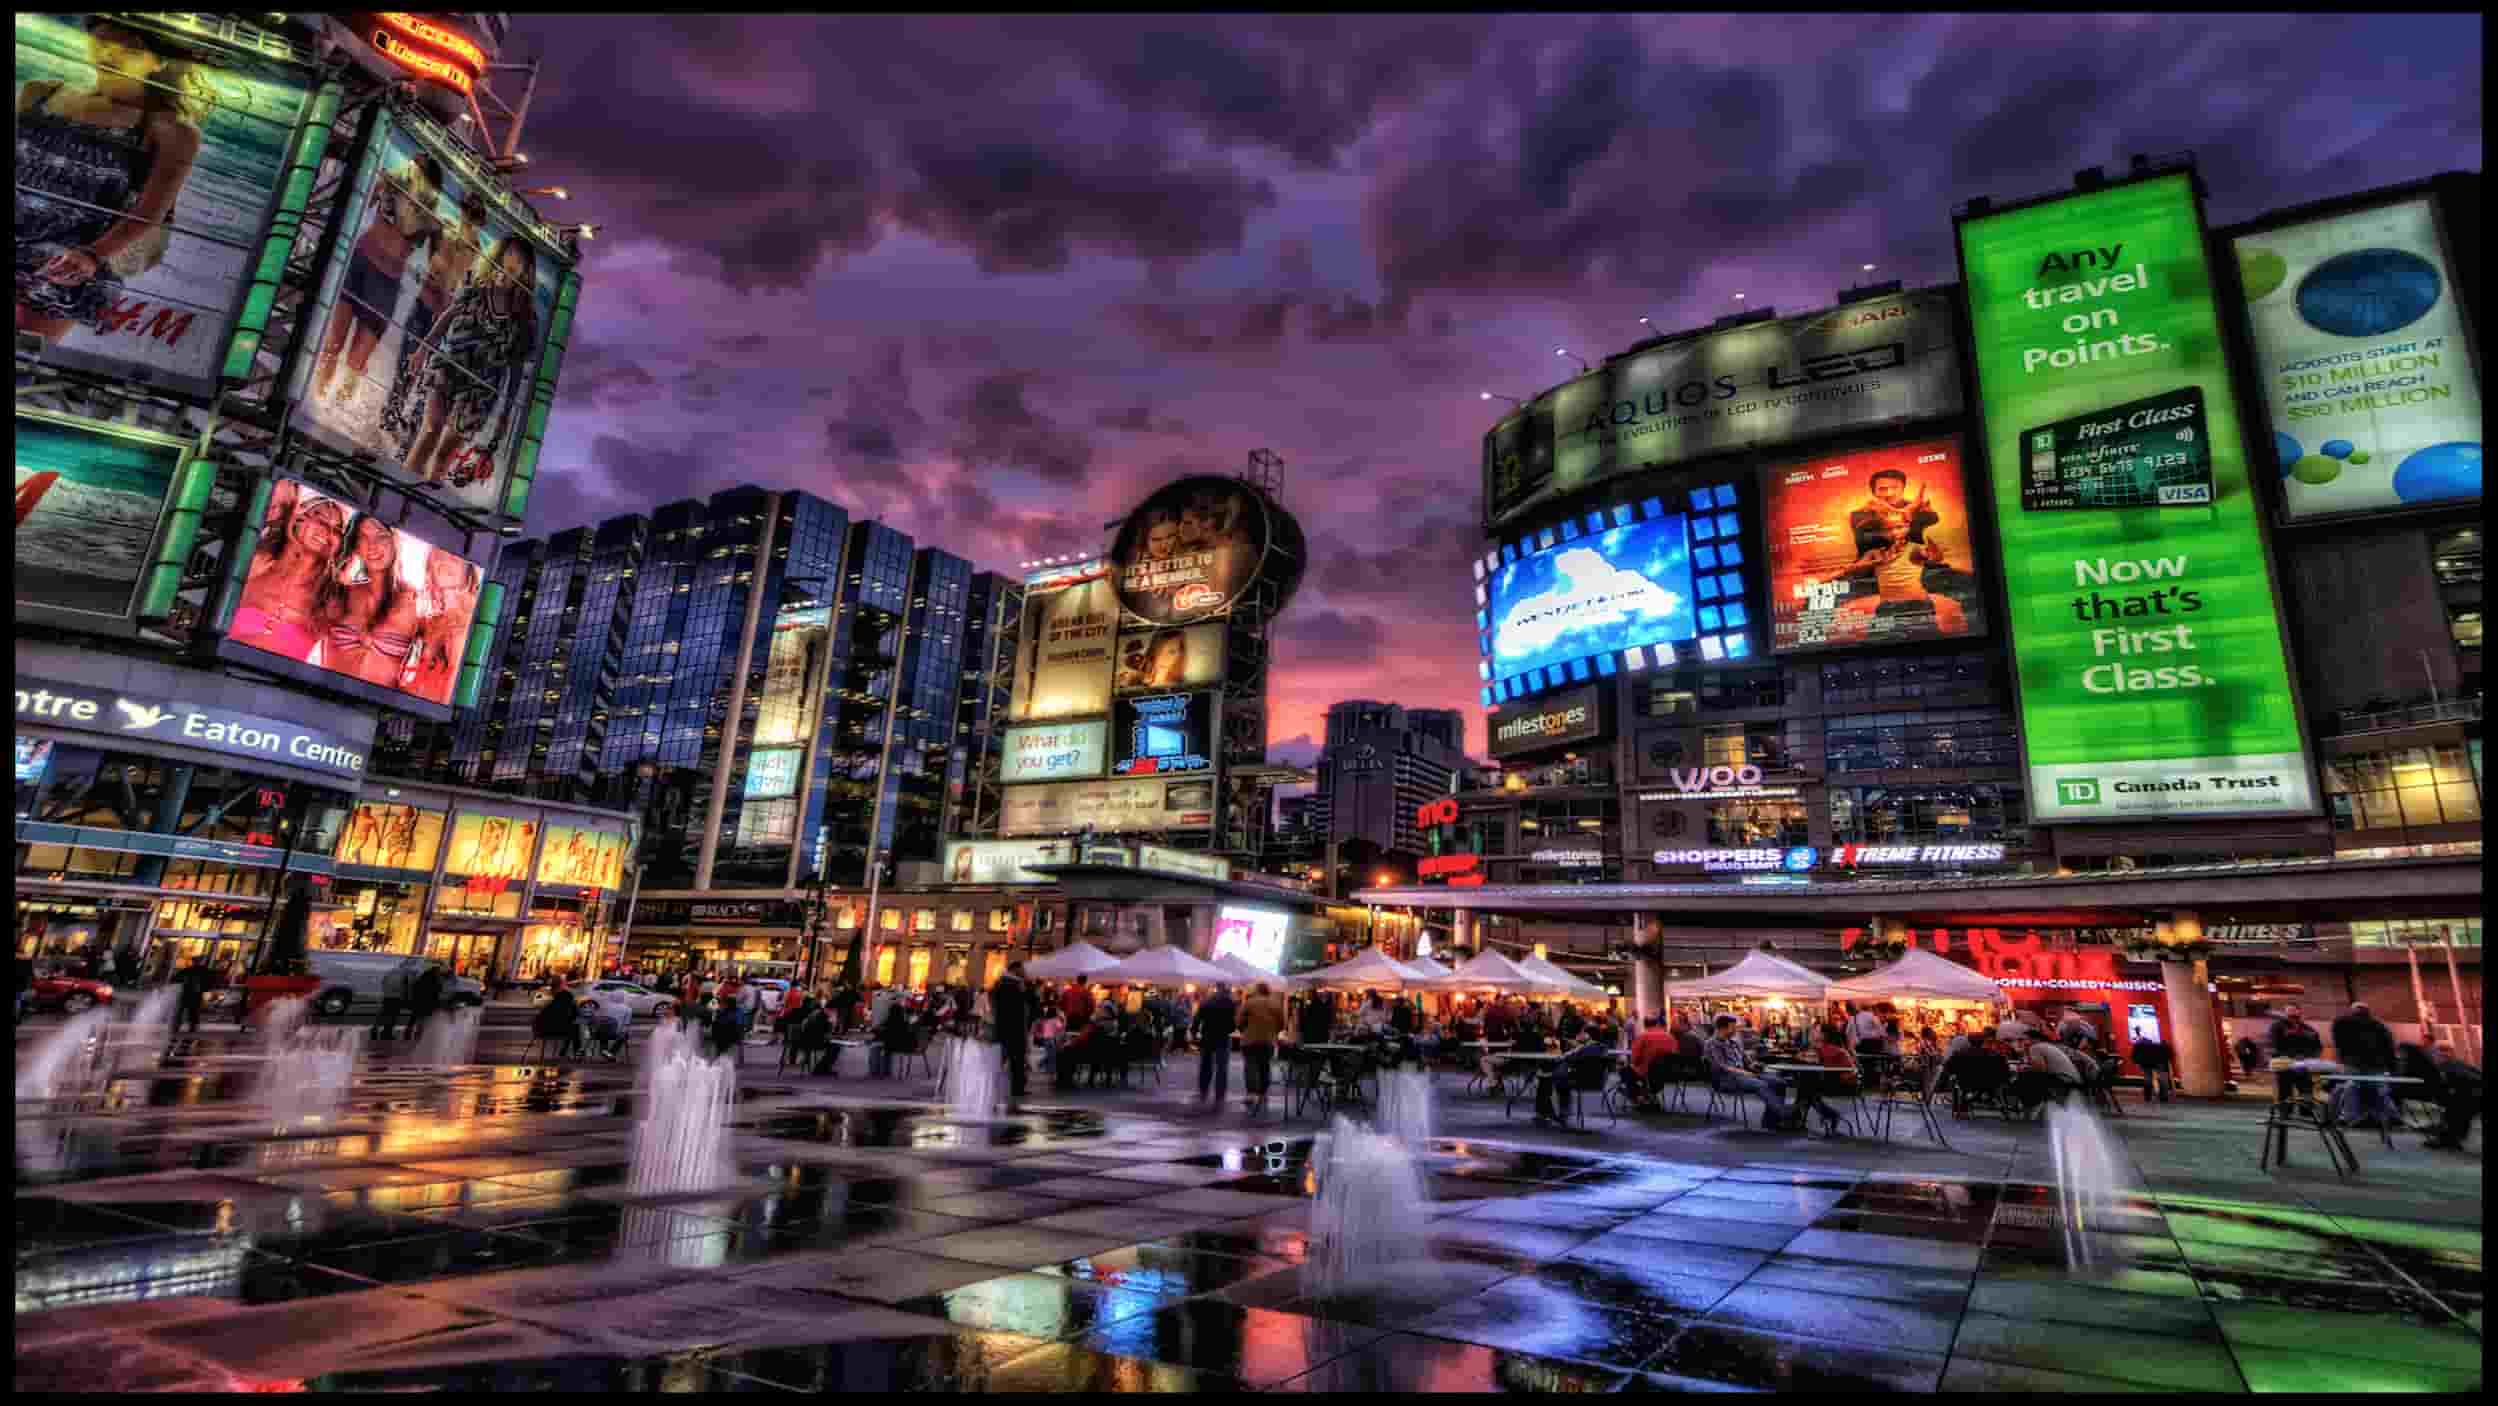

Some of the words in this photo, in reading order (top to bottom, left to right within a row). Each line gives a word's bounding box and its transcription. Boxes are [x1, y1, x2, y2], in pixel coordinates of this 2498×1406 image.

[2040, 241, 2124, 277] Any
[2023, 263, 2148, 309] travel
[2063, 307, 2119, 333] on
[2367, 342, 2417, 360] START
[2328, 353, 2441, 384] MILLION
[2364, 374, 2425, 393] REACH
[1585, 373, 1738, 433] AQUOS
[1767, 343, 1906, 390] LED
[2341, 384, 2451, 414] MILLION
[2078, 417, 2124, 440] First
[2128, 402, 2198, 429] Class
[2164, 486, 2208, 500] VISA
[2074, 555, 2188, 587] Now
[2072, 585, 2204, 622] that's
[2092, 623, 2197, 657] First
[2082, 662, 2217, 693] Class.
[1498, 705, 1586, 741] milestones
[183, 713, 281, 753] Eaton
[289, 734, 364, 772] Centre
[2063, 783, 2097, 801] TD
[2113, 777, 2201, 794] Canada
[2209, 774, 2281, 790] Trust
[1652, 848, 1782, 866] SHOPPERS
[1921, 844, 2005, 862] FITNESS
